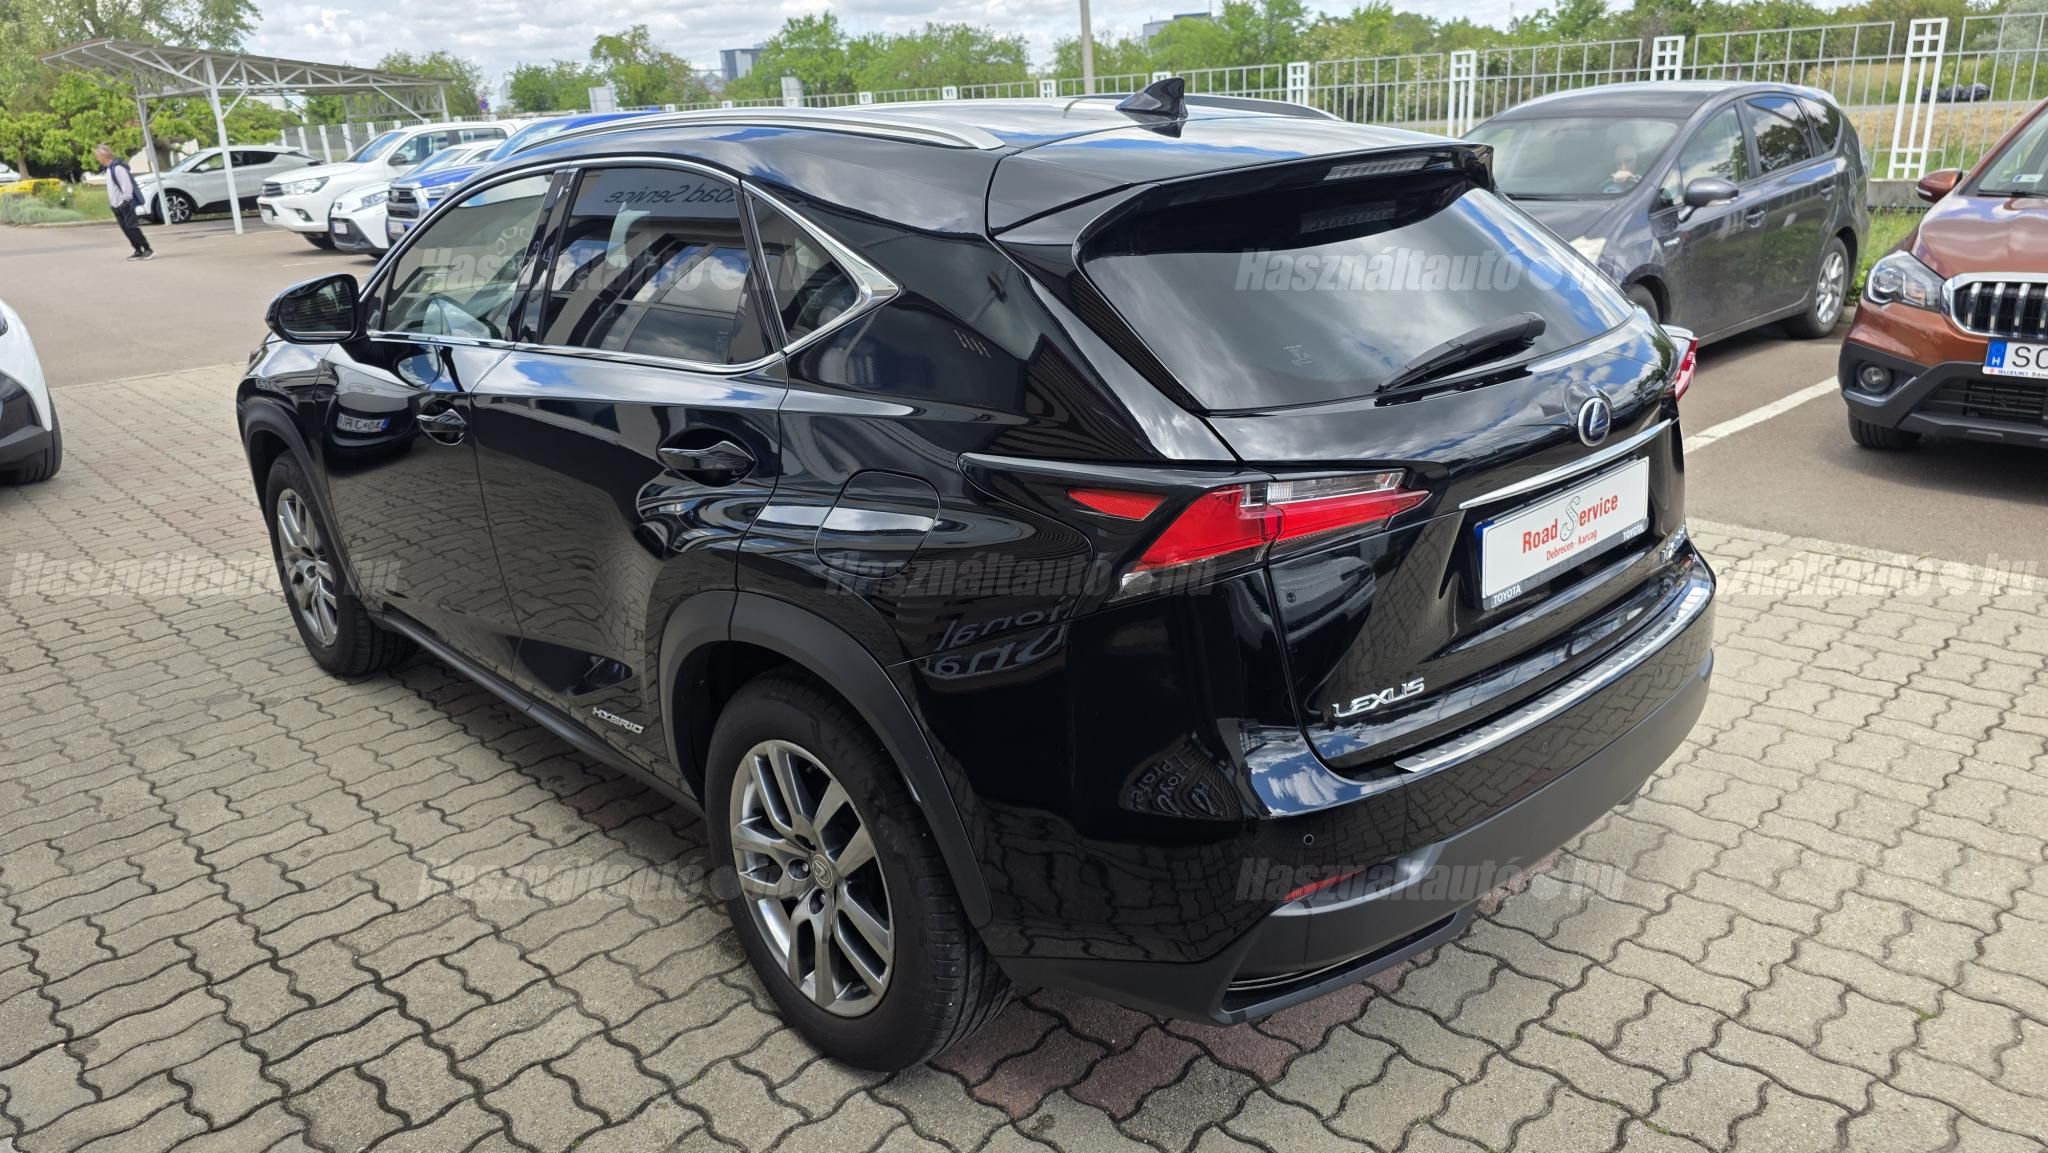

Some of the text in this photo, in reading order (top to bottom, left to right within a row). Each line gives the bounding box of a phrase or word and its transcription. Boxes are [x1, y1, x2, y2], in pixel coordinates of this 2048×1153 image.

[1992, 356, 2001, 366] H
[1522, 495, 1619, 554] Road Service
[1622, 524, 1644, 541] TOYOTA
[1545, 541, 1574, 561] Debrecen
[1578, 530, 1598, 545] Karcag
[1493, 584, 1521, 605] TOYOTA
[1332, 677, 1425, 718] LEXUS
[592, 706, 644, 734] HYBRID
